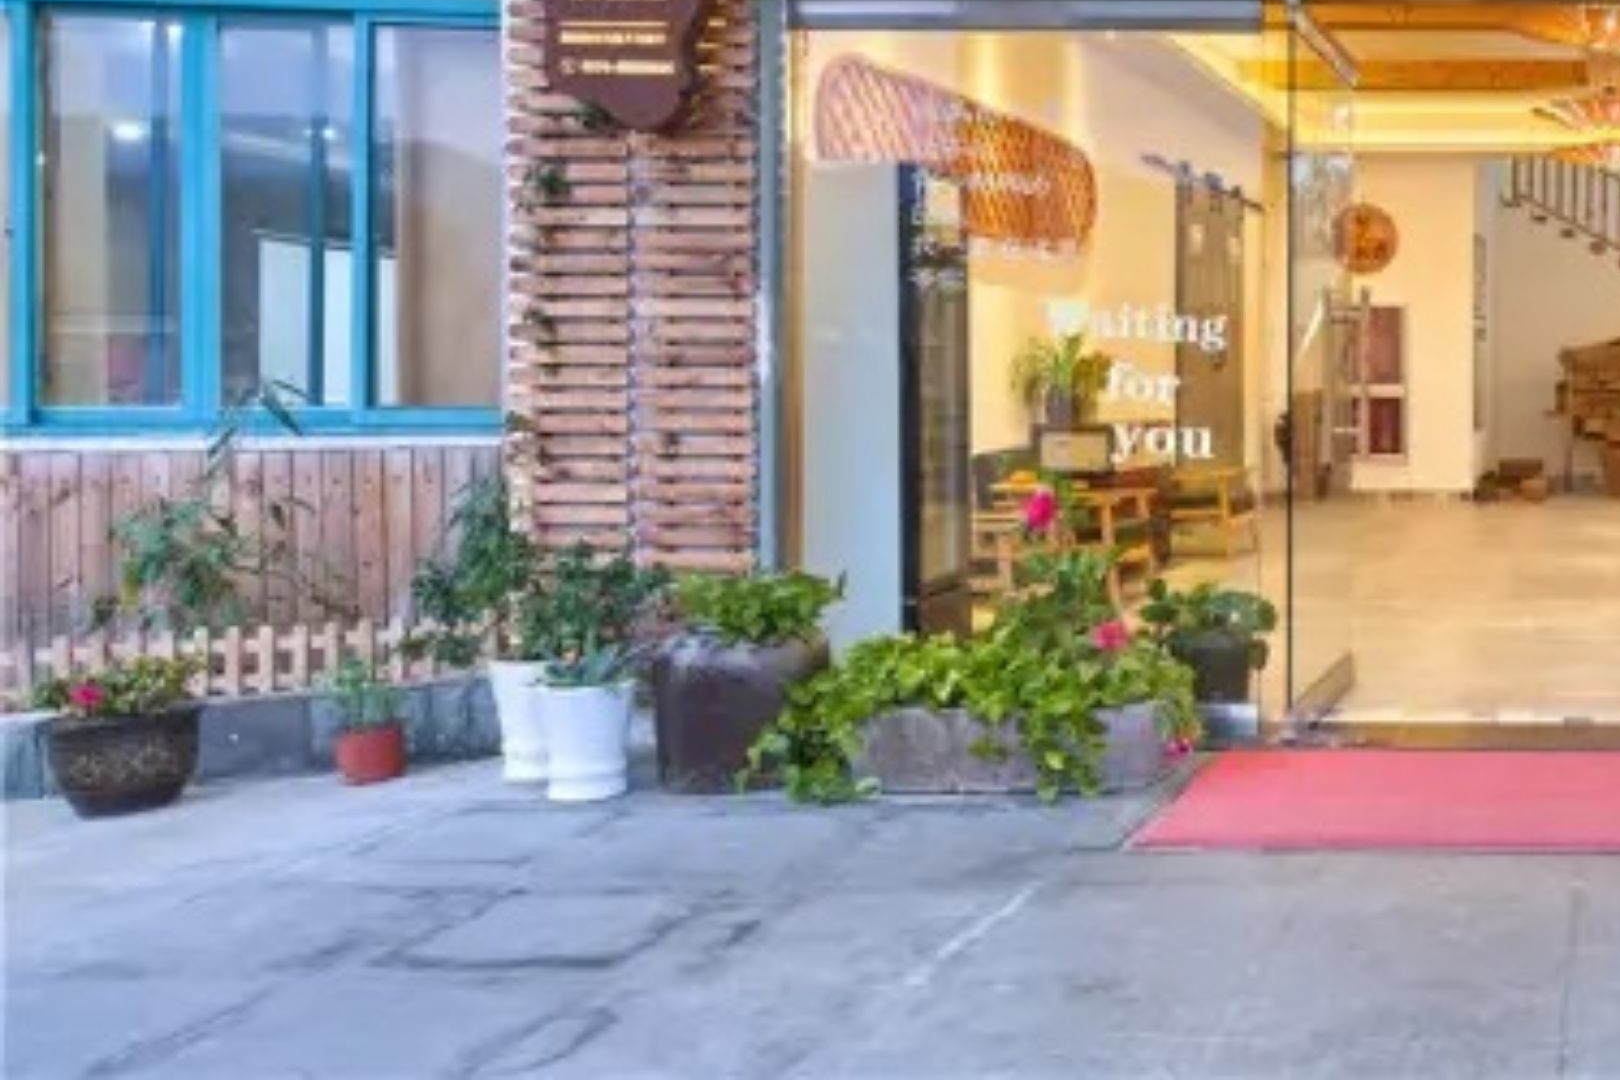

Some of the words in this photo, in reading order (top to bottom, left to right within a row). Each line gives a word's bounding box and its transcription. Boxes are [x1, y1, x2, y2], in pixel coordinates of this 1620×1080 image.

[1046, 298, 1228, 351] Waiting
[1105, 360, 1180, 402] for
[1110, 423, 1213, 463] you
